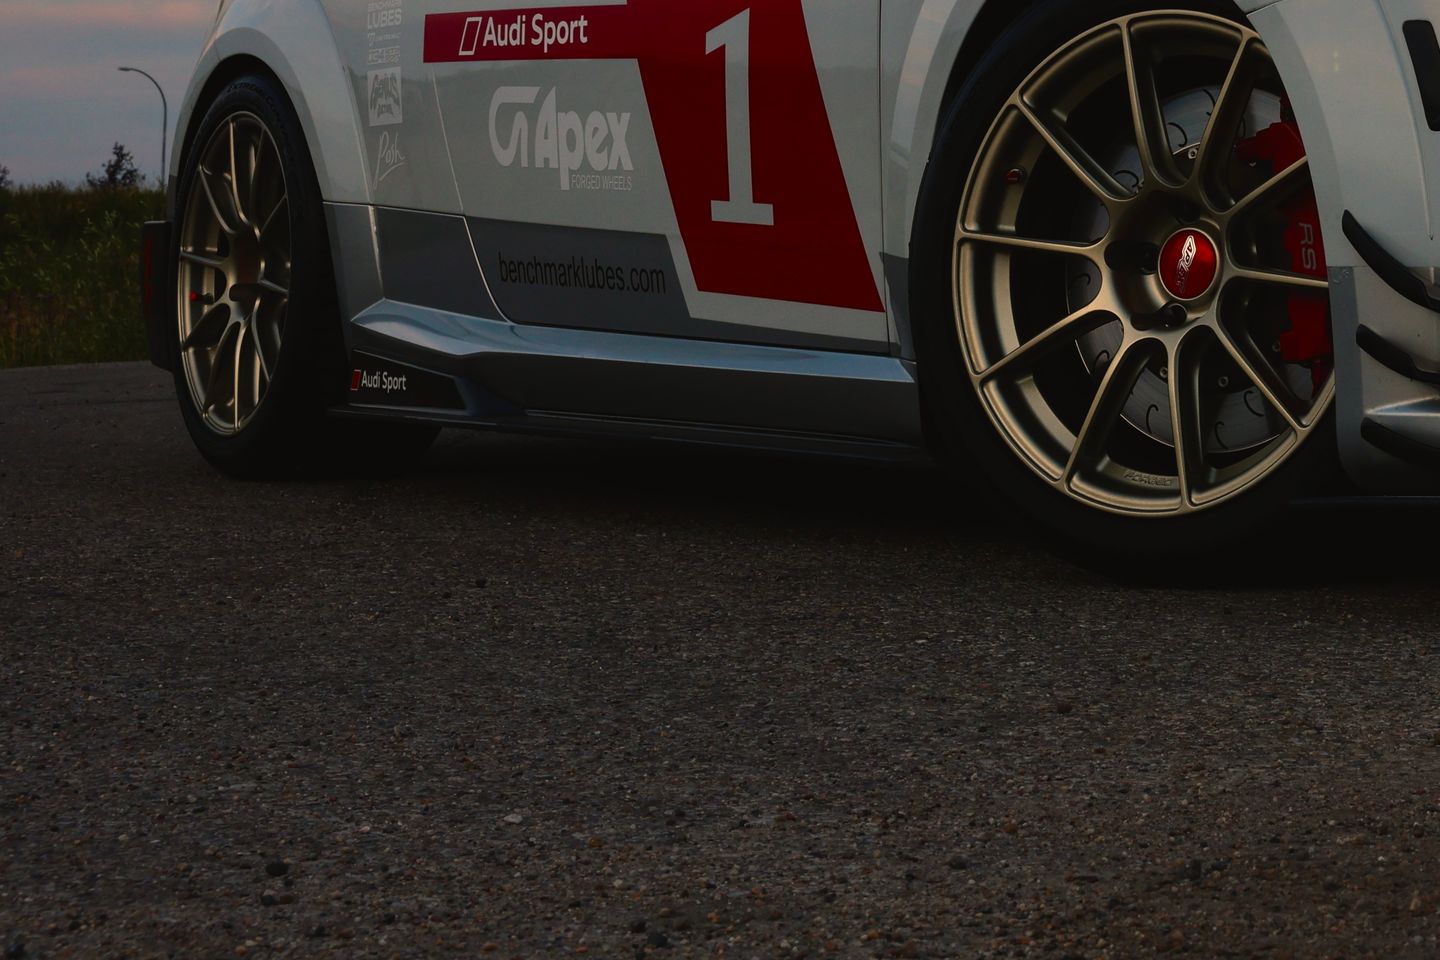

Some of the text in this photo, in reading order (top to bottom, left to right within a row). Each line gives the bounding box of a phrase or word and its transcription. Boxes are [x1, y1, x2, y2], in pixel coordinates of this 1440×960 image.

[368, 9, 402, 30] LUBES
[483, 13, 589, 53] Audi Sport
[705, 7, 775, 227] 1
[571, 174, 633, 191] FORGED WHEELS
[1297, 222, 1317, 271] RS
[498, 252, 667, 296] benchmarklubes.com
[361, 370, 407, 394] Audi Sport
